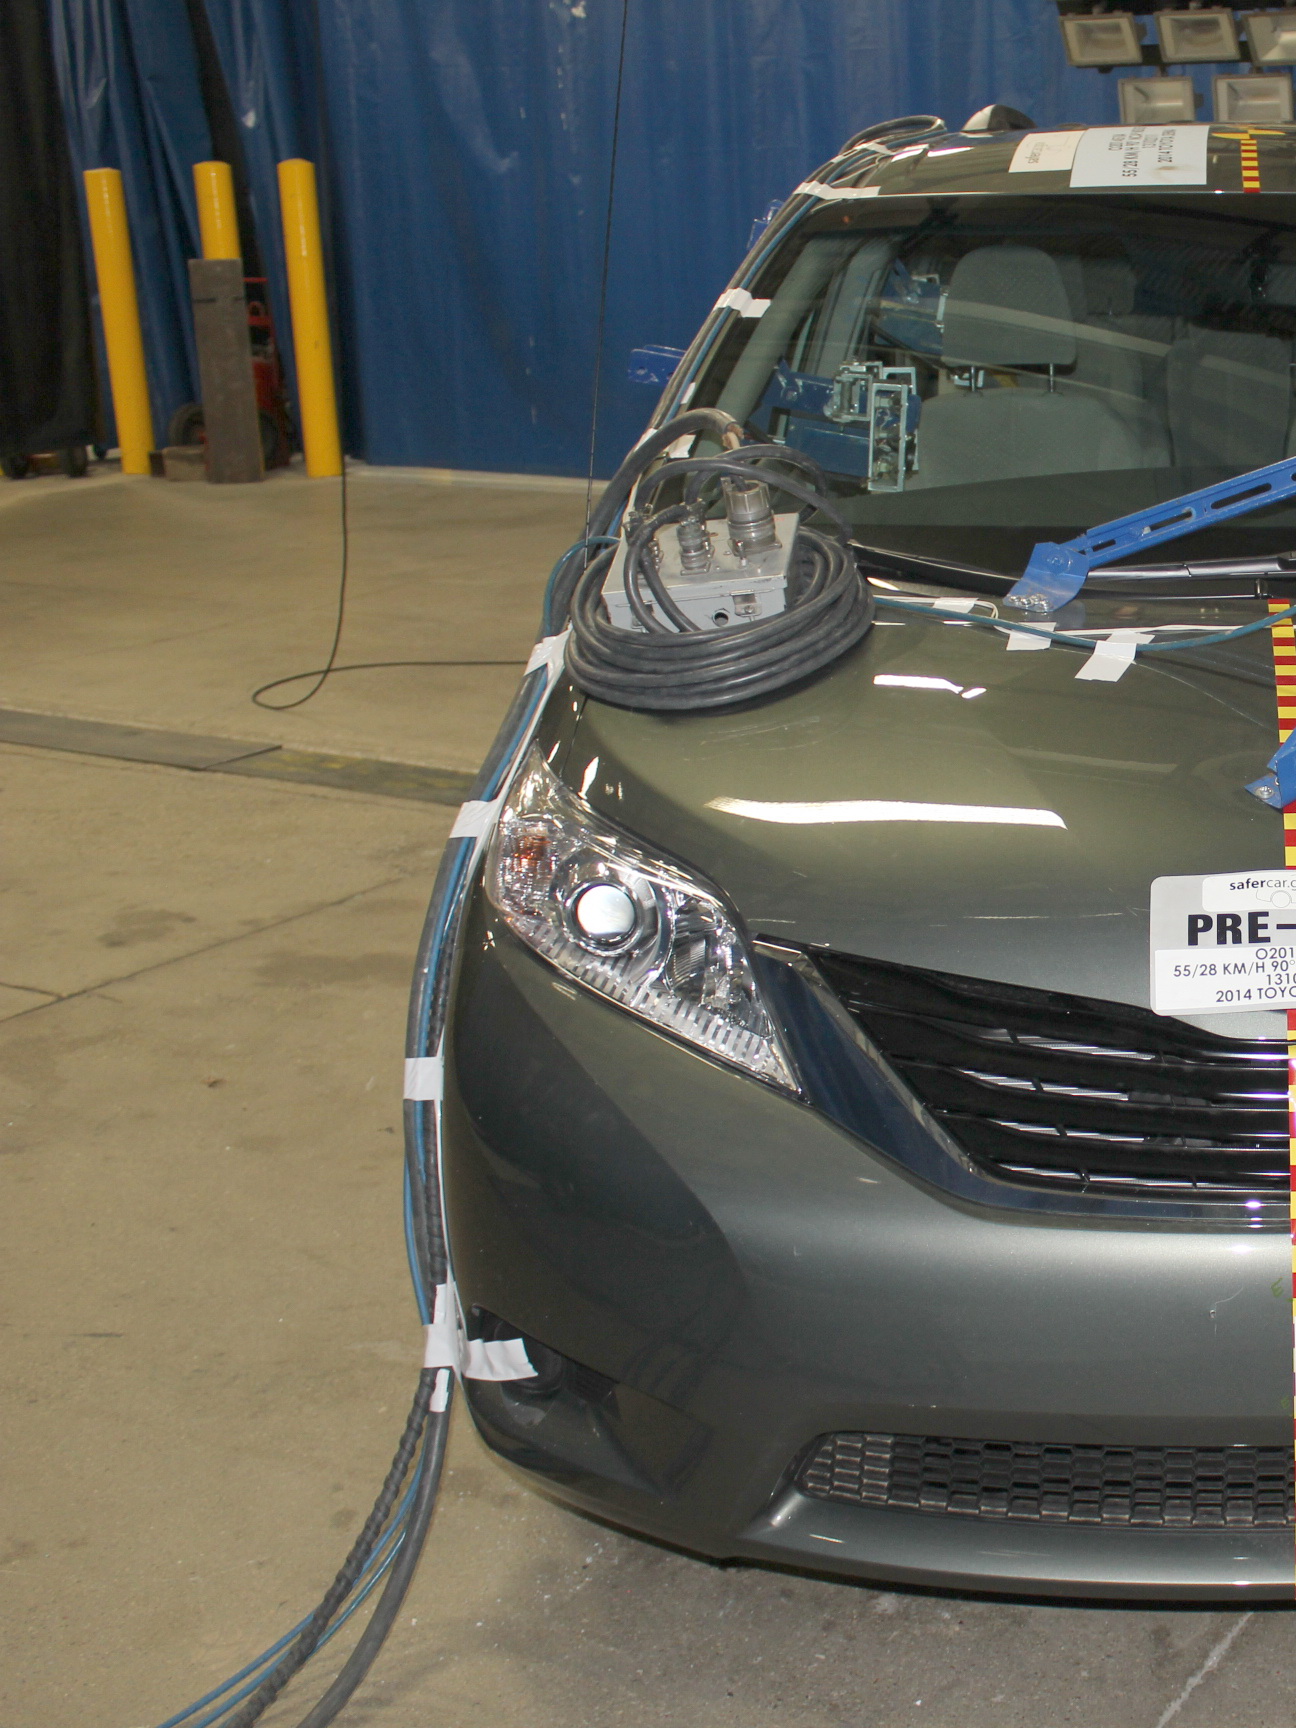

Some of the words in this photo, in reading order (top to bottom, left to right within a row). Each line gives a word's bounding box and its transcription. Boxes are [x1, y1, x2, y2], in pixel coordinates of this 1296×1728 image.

[1174, 964, 1217, 978] 55/28
[1223, 962, 1265, 975] KM/H
[1271, 959, 1296, 973] 90°
[1216, 989, 1252, 1002] 2014
